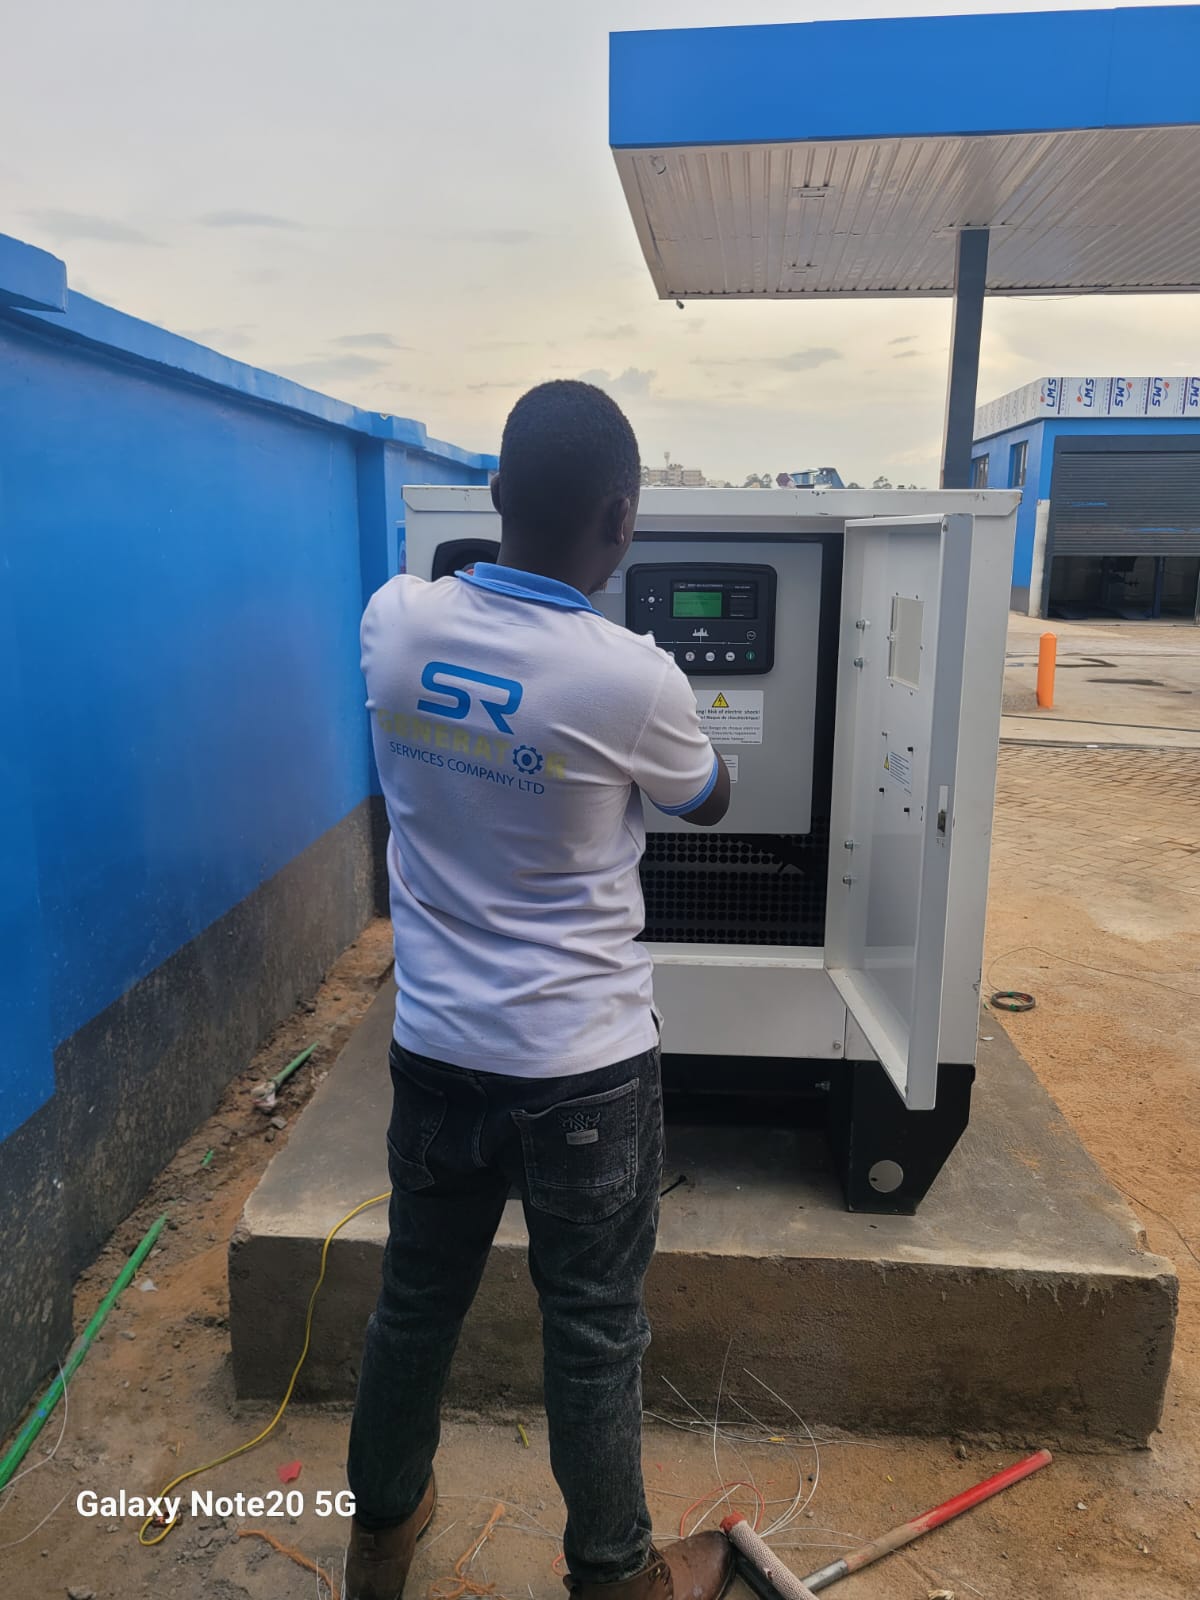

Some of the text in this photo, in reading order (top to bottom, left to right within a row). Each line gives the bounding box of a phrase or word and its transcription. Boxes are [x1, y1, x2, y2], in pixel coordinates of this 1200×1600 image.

[1046, 378, 1057, 408] LMS
[1083, 378, 1095, 408] LMS
[1114, 377, 1126, 408] LMS
[1151, 377, 1163, 408] LMS
[417, 661, 524, 735] SR
[389, 741, 545, 795] SERVICES COMPANY LTD
